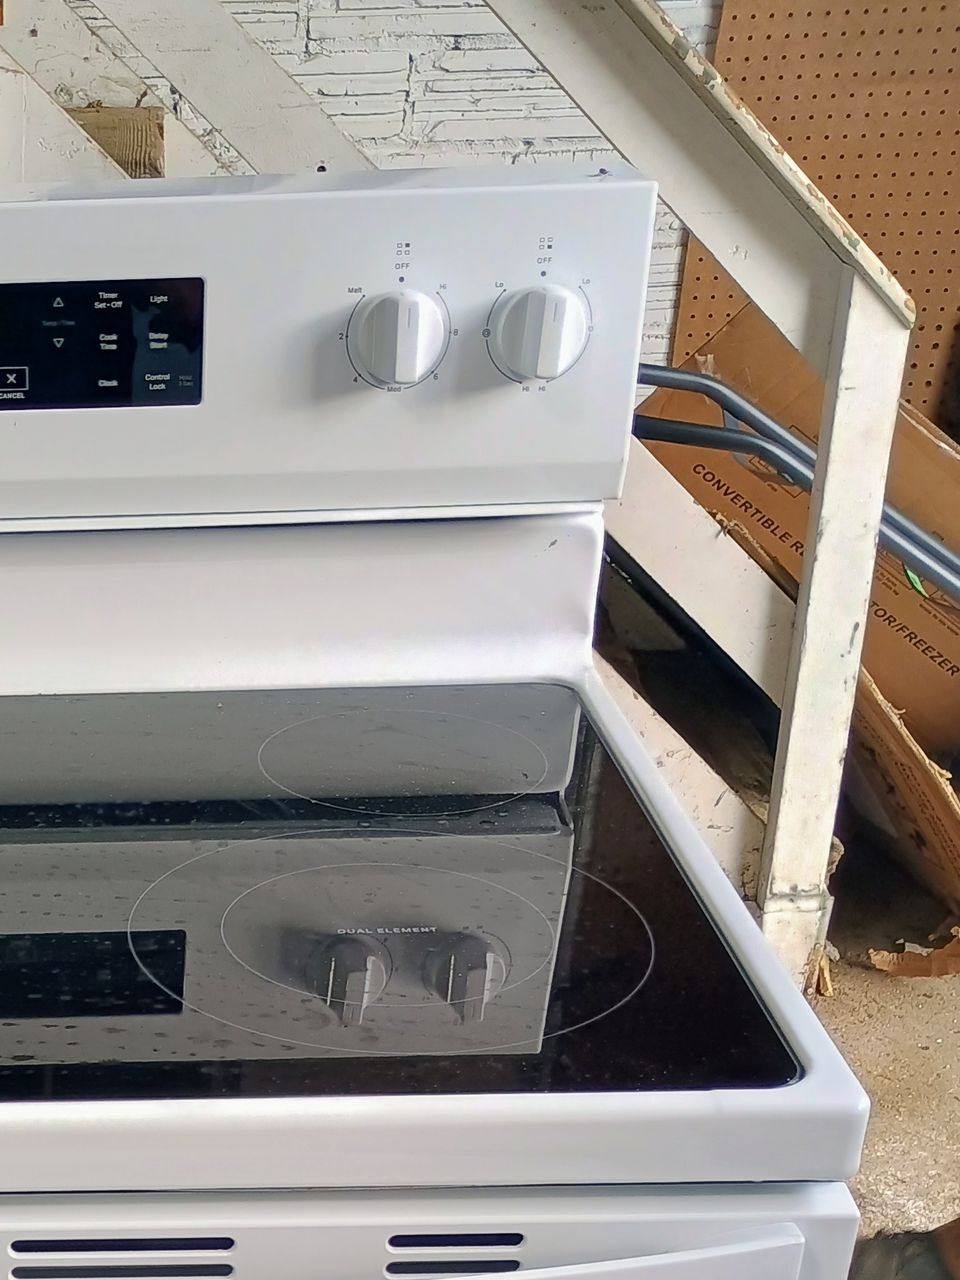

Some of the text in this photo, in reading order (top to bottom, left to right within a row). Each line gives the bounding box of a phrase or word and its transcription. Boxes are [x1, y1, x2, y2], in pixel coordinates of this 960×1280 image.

[395, 262, 410, 270] OFF
[150, 295, 169, 304] Light
[149, 383, 166, 391] Lock
[692, 463, 793, 543] CONVERTIBLE
